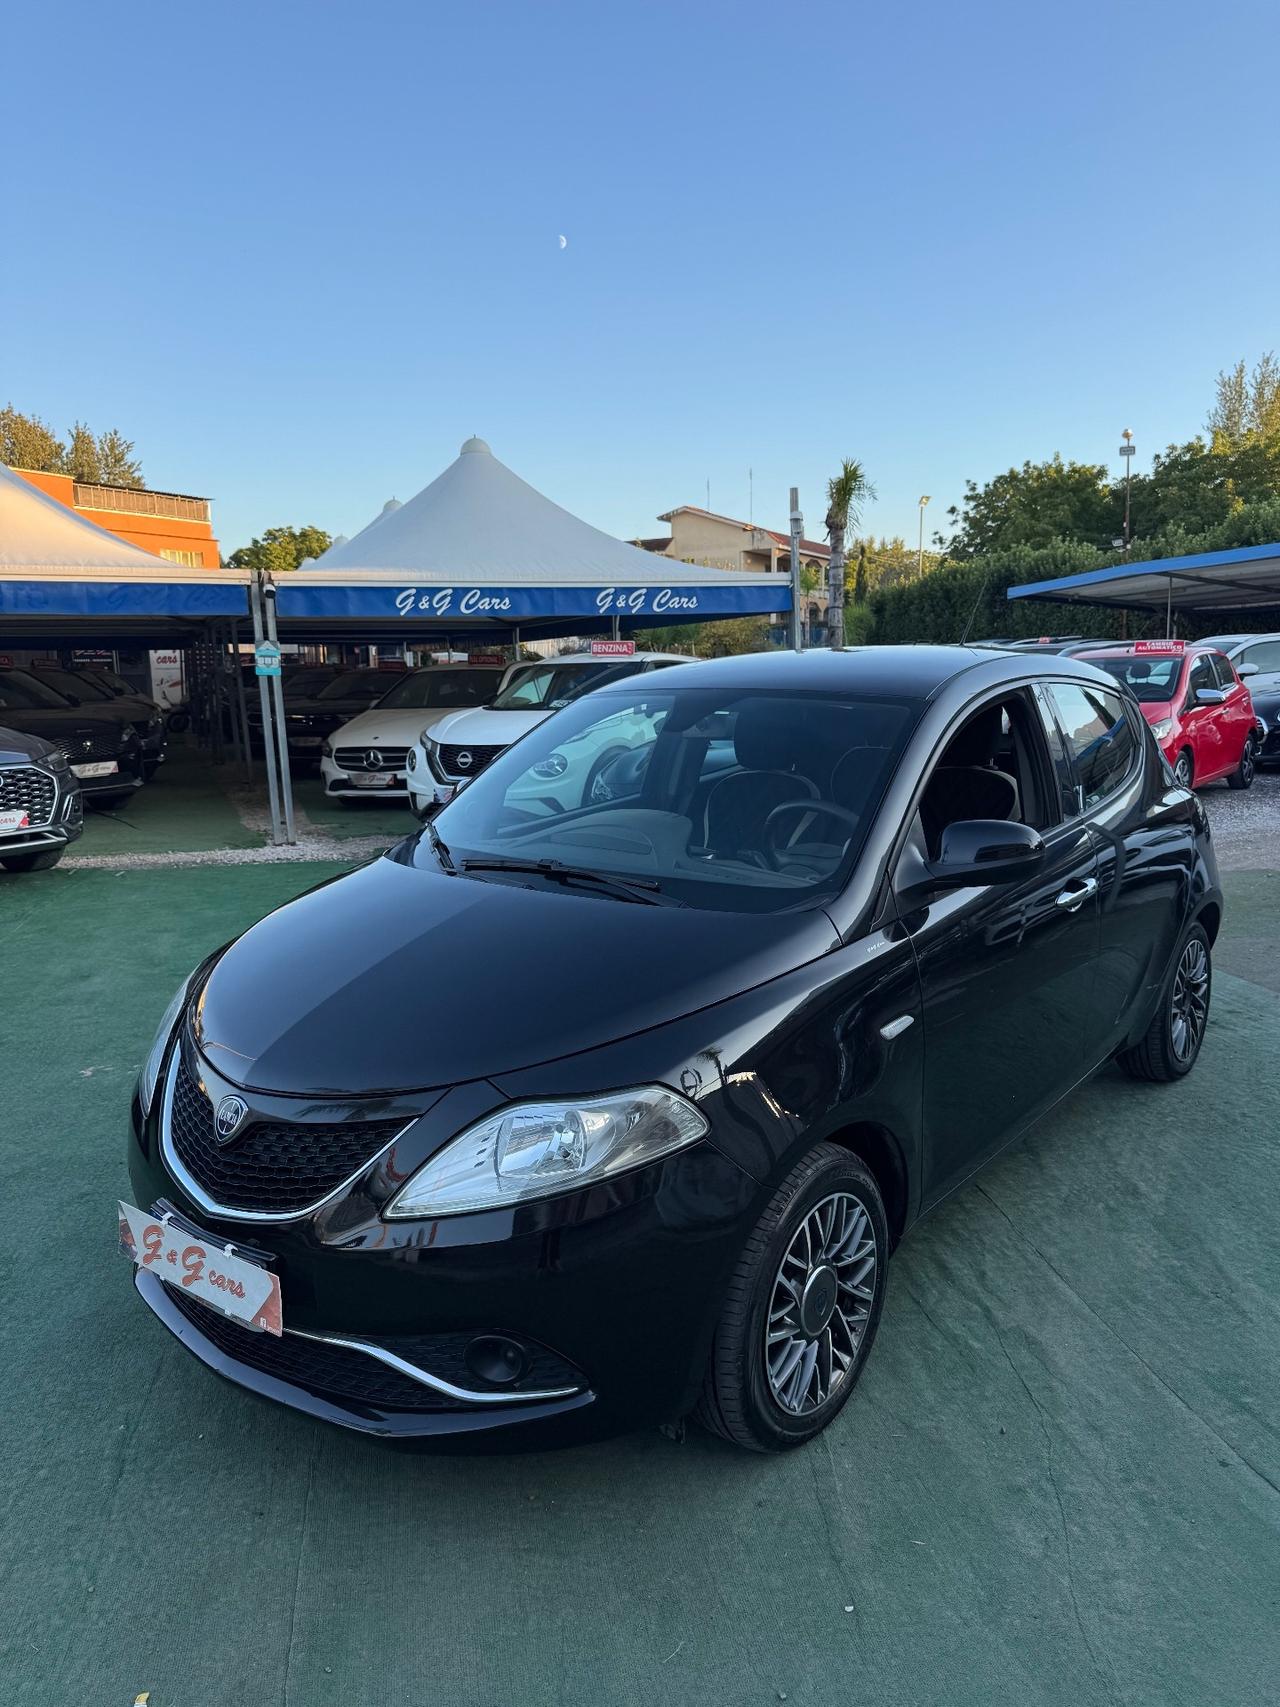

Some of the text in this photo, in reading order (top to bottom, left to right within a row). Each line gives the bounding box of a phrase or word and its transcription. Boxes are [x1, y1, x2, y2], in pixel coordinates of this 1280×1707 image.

[460, 589, 511, 613] Cars
[652, 589, 698, 612] Cars
[156, 655, 177, 665] cars
[592, 644, 628, 653] BENZINA
[208, 1270, 246, 1299] cars
